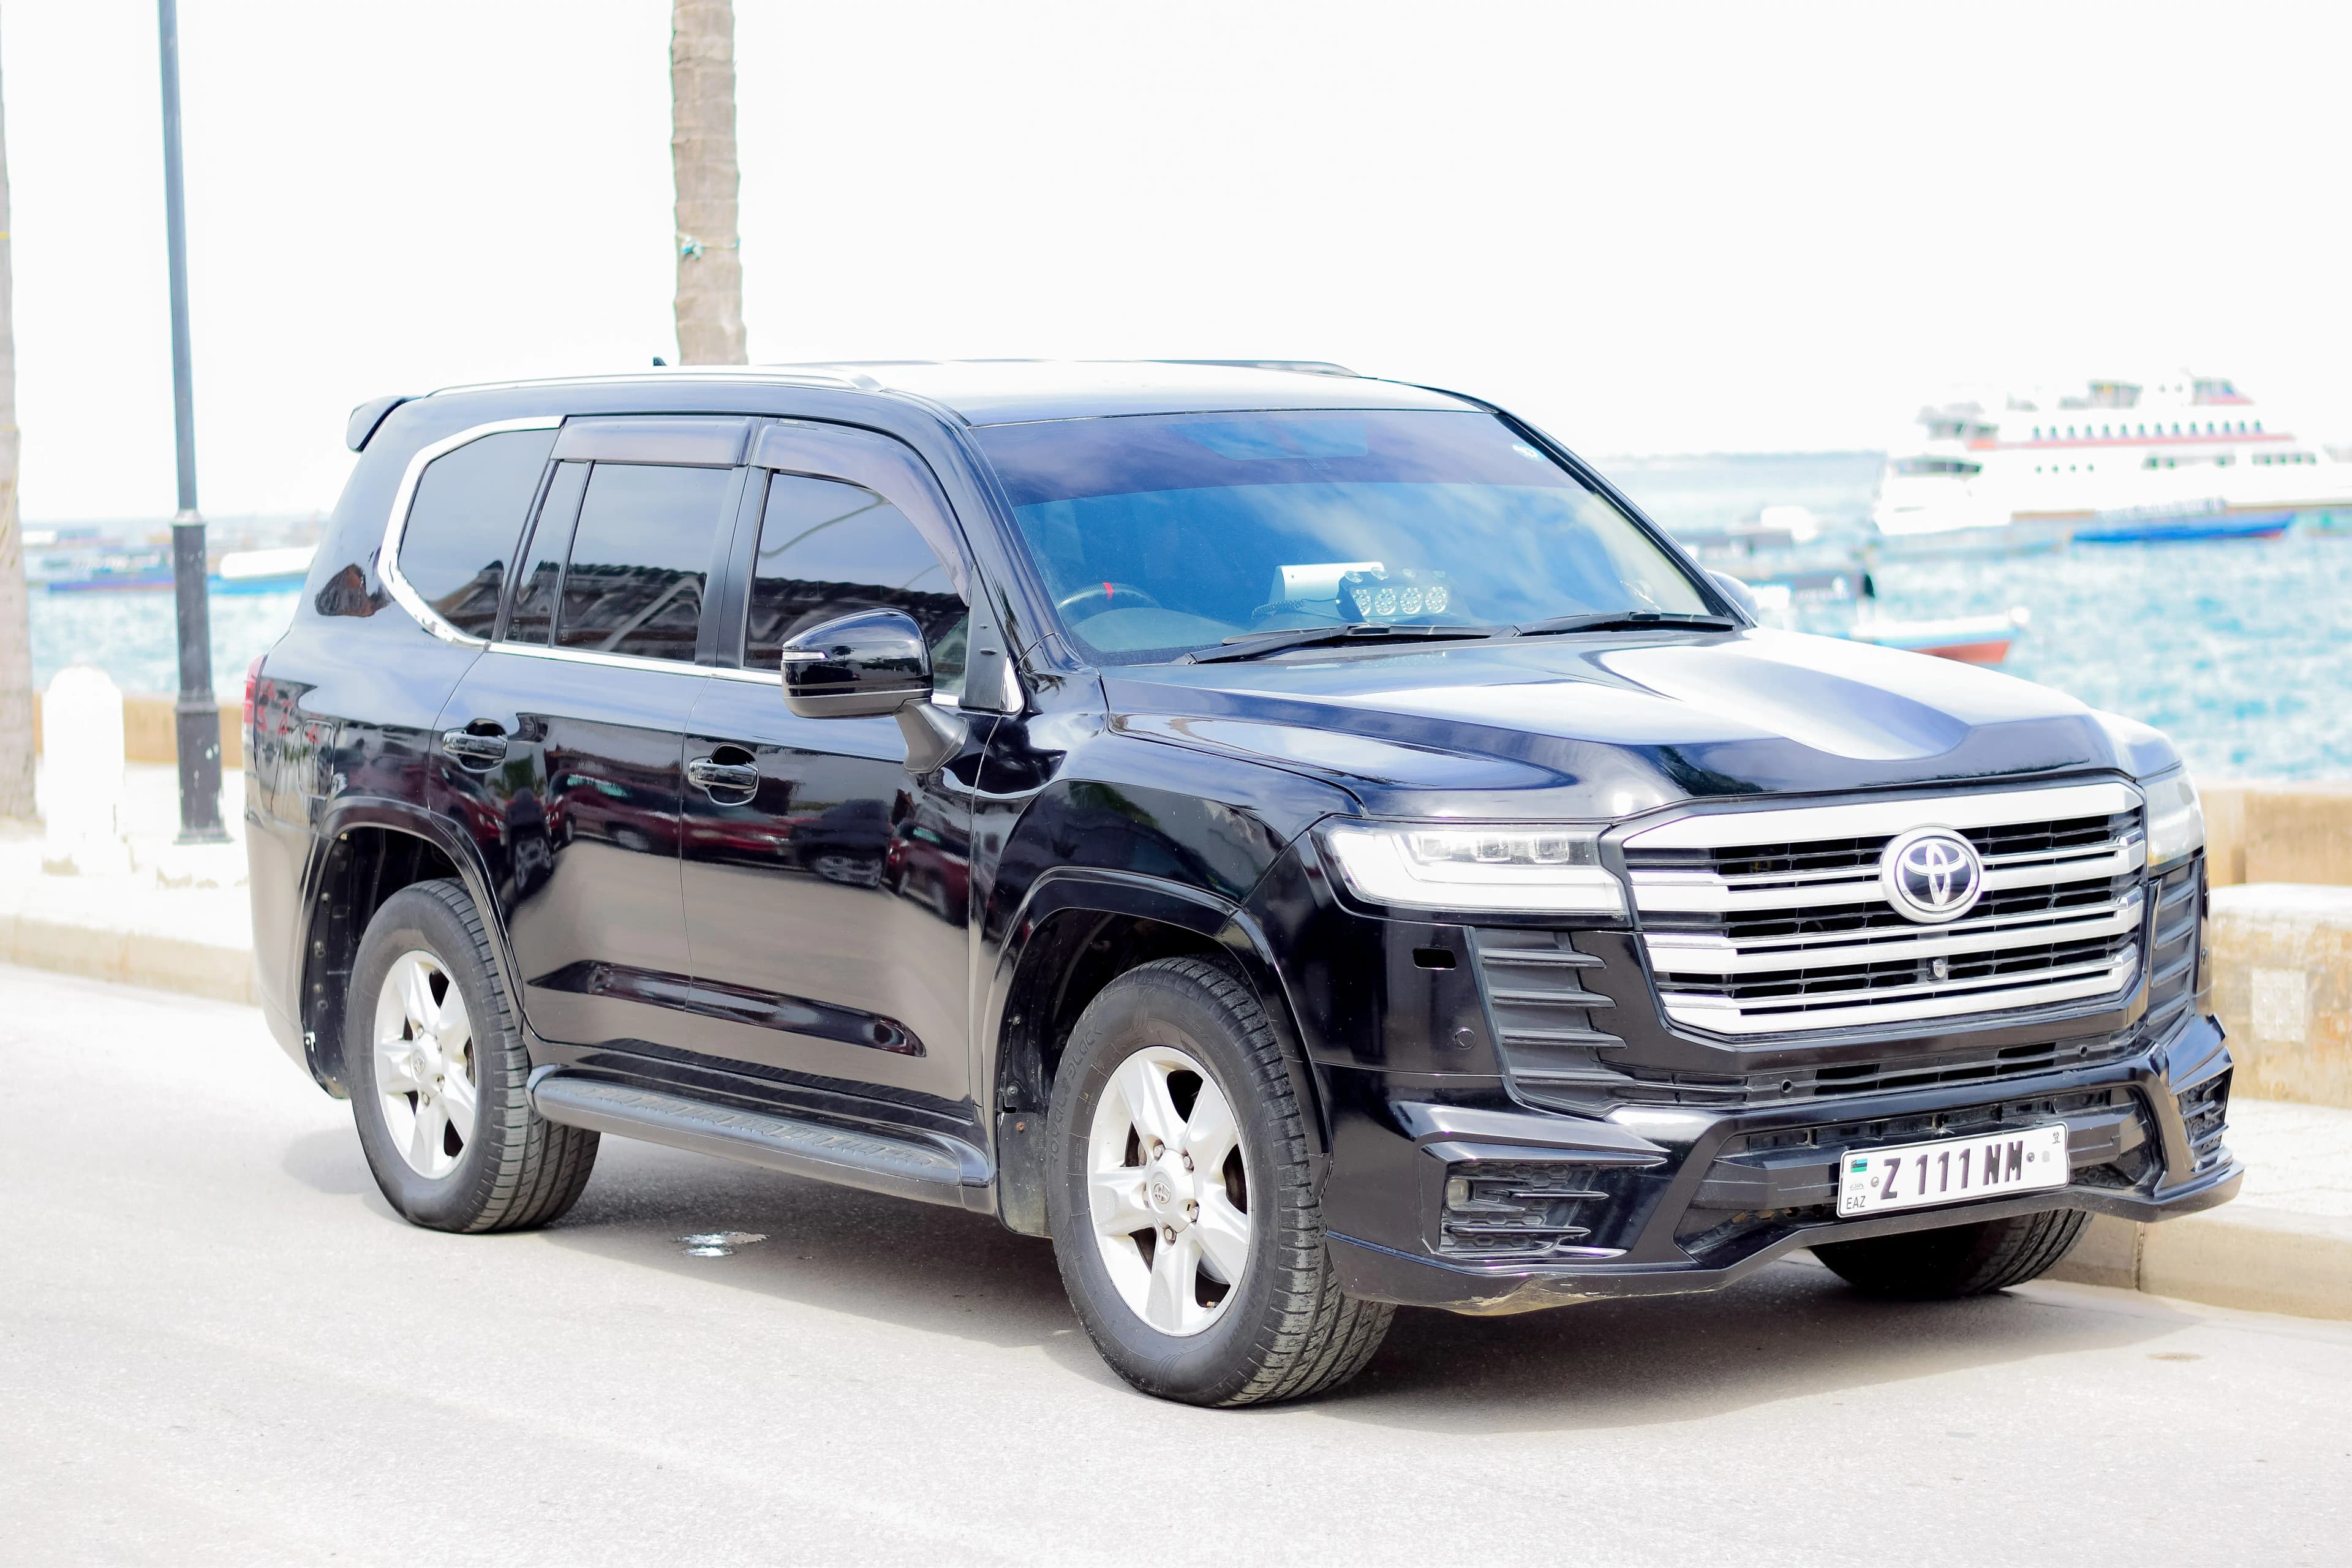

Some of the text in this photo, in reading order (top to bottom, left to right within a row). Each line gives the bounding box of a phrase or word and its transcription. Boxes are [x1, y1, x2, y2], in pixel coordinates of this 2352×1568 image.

[1880, 1140, 2023, 1200] Z 111 NM
[1846, 1195, 1866, 1210] EAZ
